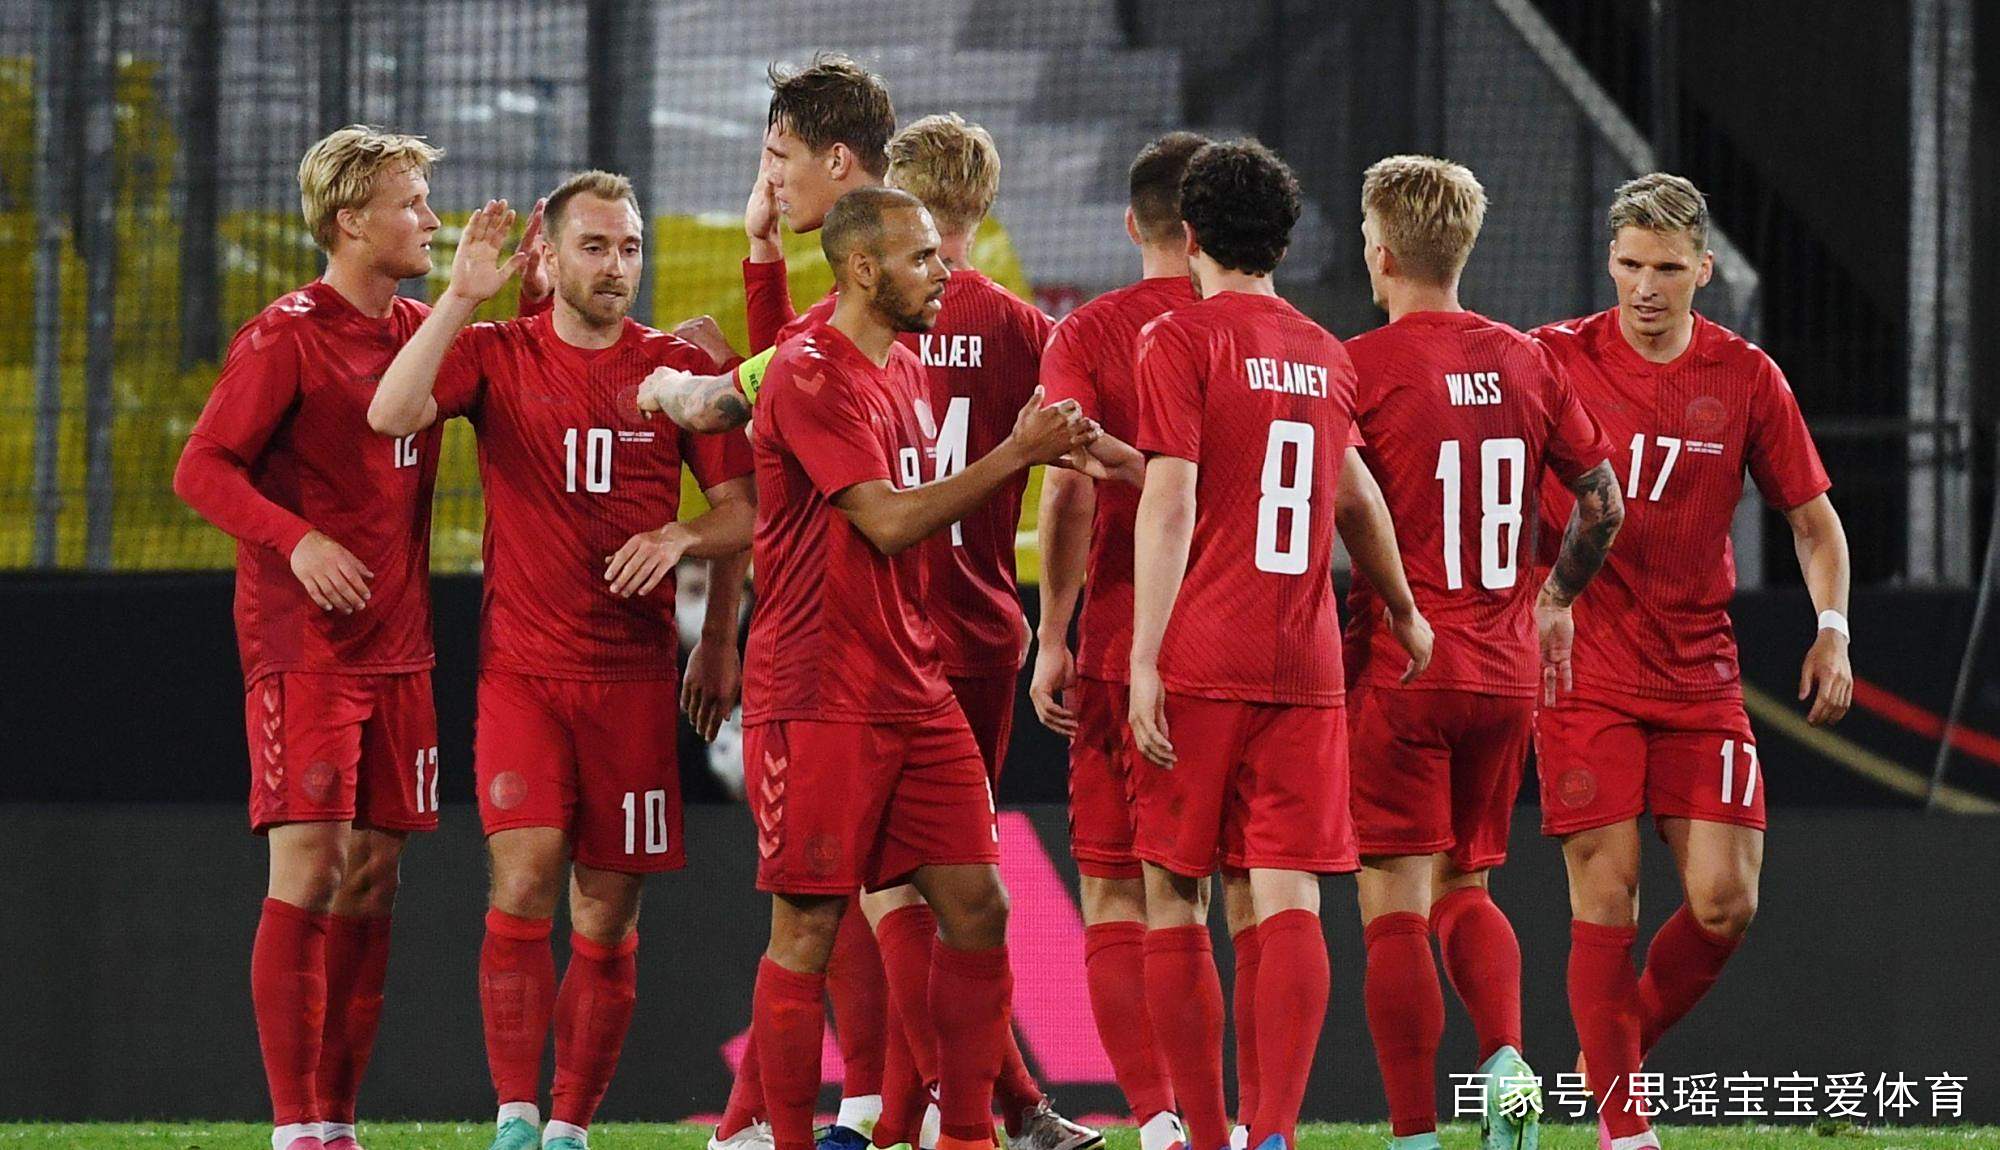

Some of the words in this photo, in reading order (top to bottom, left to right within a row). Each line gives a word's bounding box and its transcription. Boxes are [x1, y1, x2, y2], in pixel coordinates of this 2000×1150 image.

[919, 334, 983, 367] KJÆR
[1245, 358, 1328, 399] DELANEY
[1445, 372, 1502, 406] WASS
[562, 428, 613, 493] 10
[1627, 432, 1682, 501] 17
[1255, 419, 1315, 575] 8
[1435, 438, 1526, 591] 18
[1720, 739, 1758, 807] 17
[621, 789, 668, 855] 10
